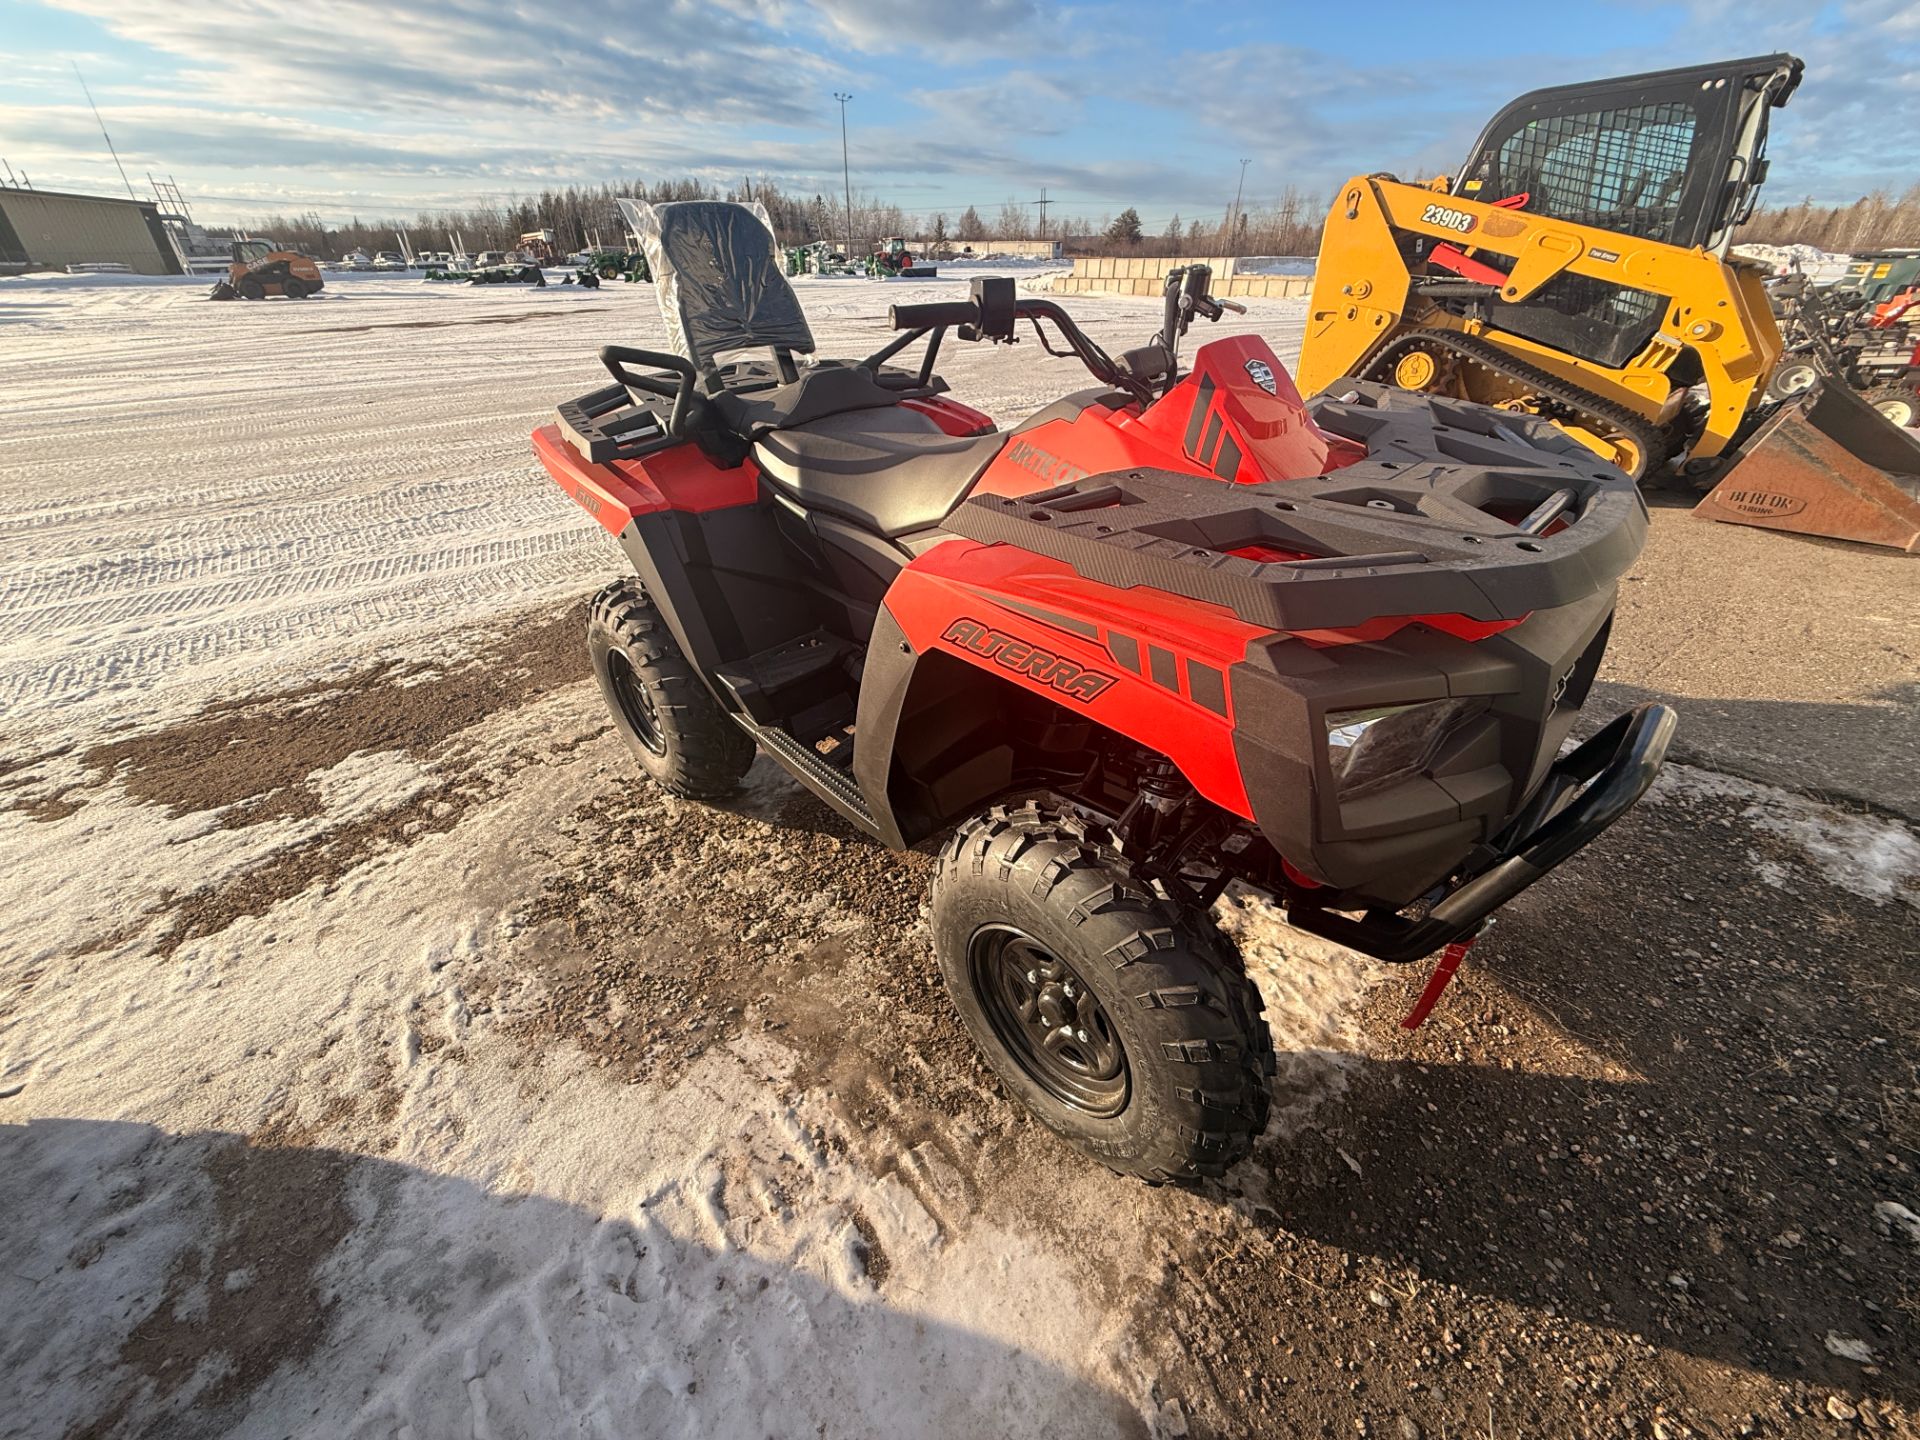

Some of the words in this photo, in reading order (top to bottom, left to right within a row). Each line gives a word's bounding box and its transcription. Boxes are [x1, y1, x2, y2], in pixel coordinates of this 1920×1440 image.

[1421, 204, 1474, 232] 239D3
[246, 256, 269, 270] CASE
[1007, 440, 1059, 481] ARCTIC
[942, 619, 1113, 700] ALTERRA
